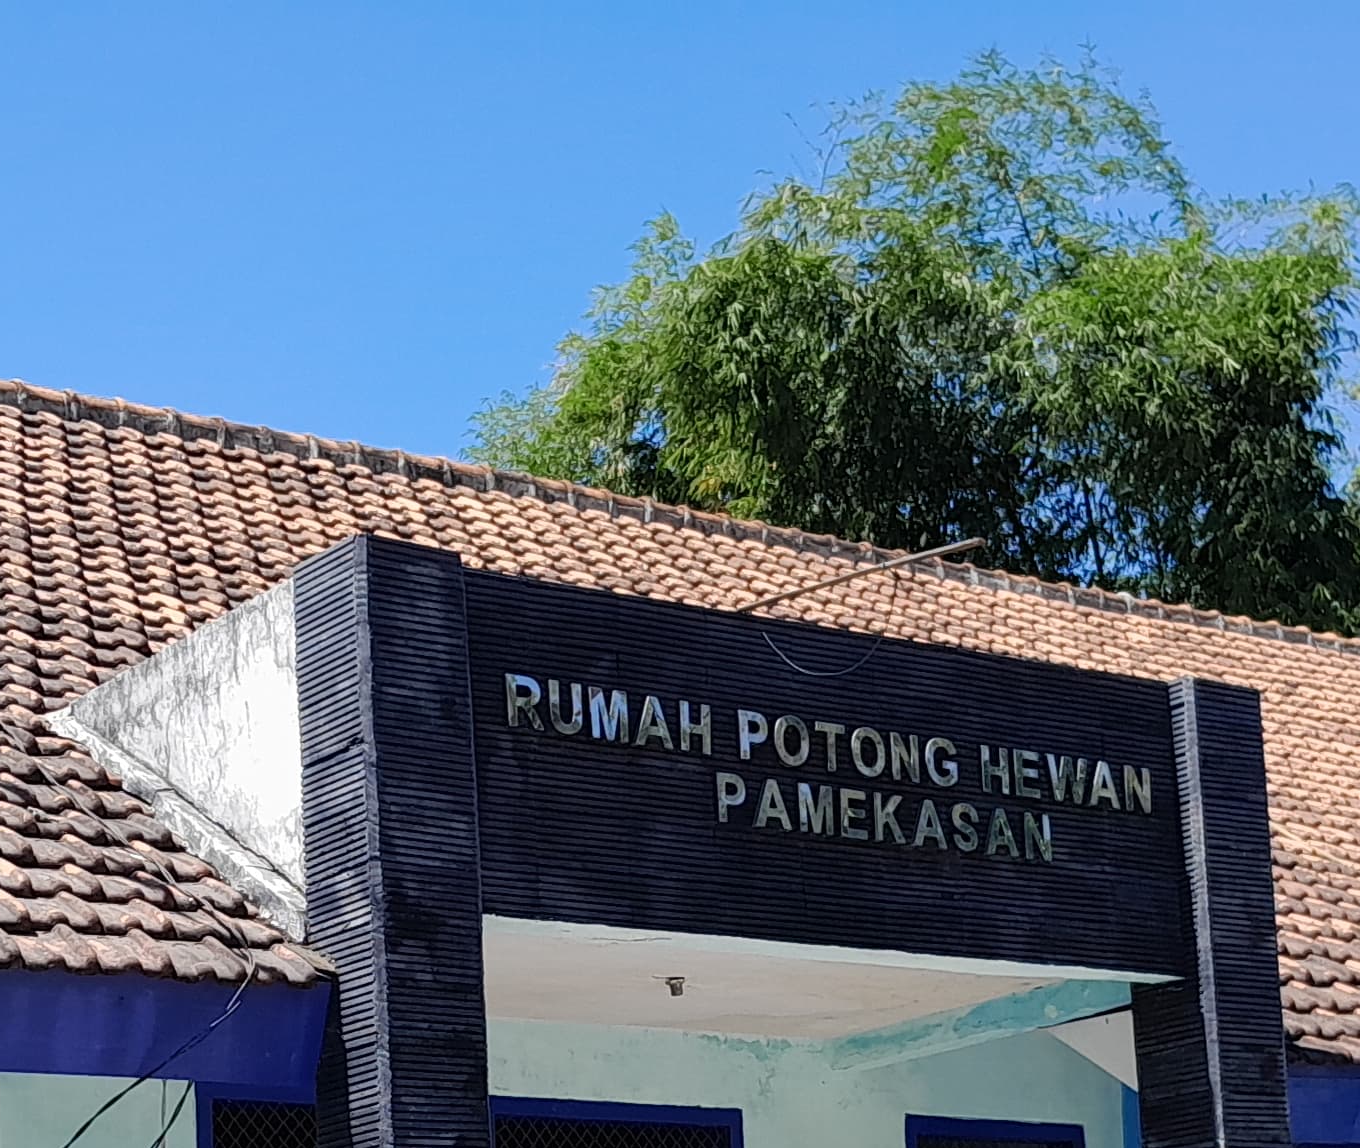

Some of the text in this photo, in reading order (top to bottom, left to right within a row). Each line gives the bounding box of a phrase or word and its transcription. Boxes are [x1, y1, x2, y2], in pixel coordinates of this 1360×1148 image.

[504, 672, 1153, 815] RUMAH POTONG HEWAN
[715, 771, 1054, 864] PAMEKASAN
